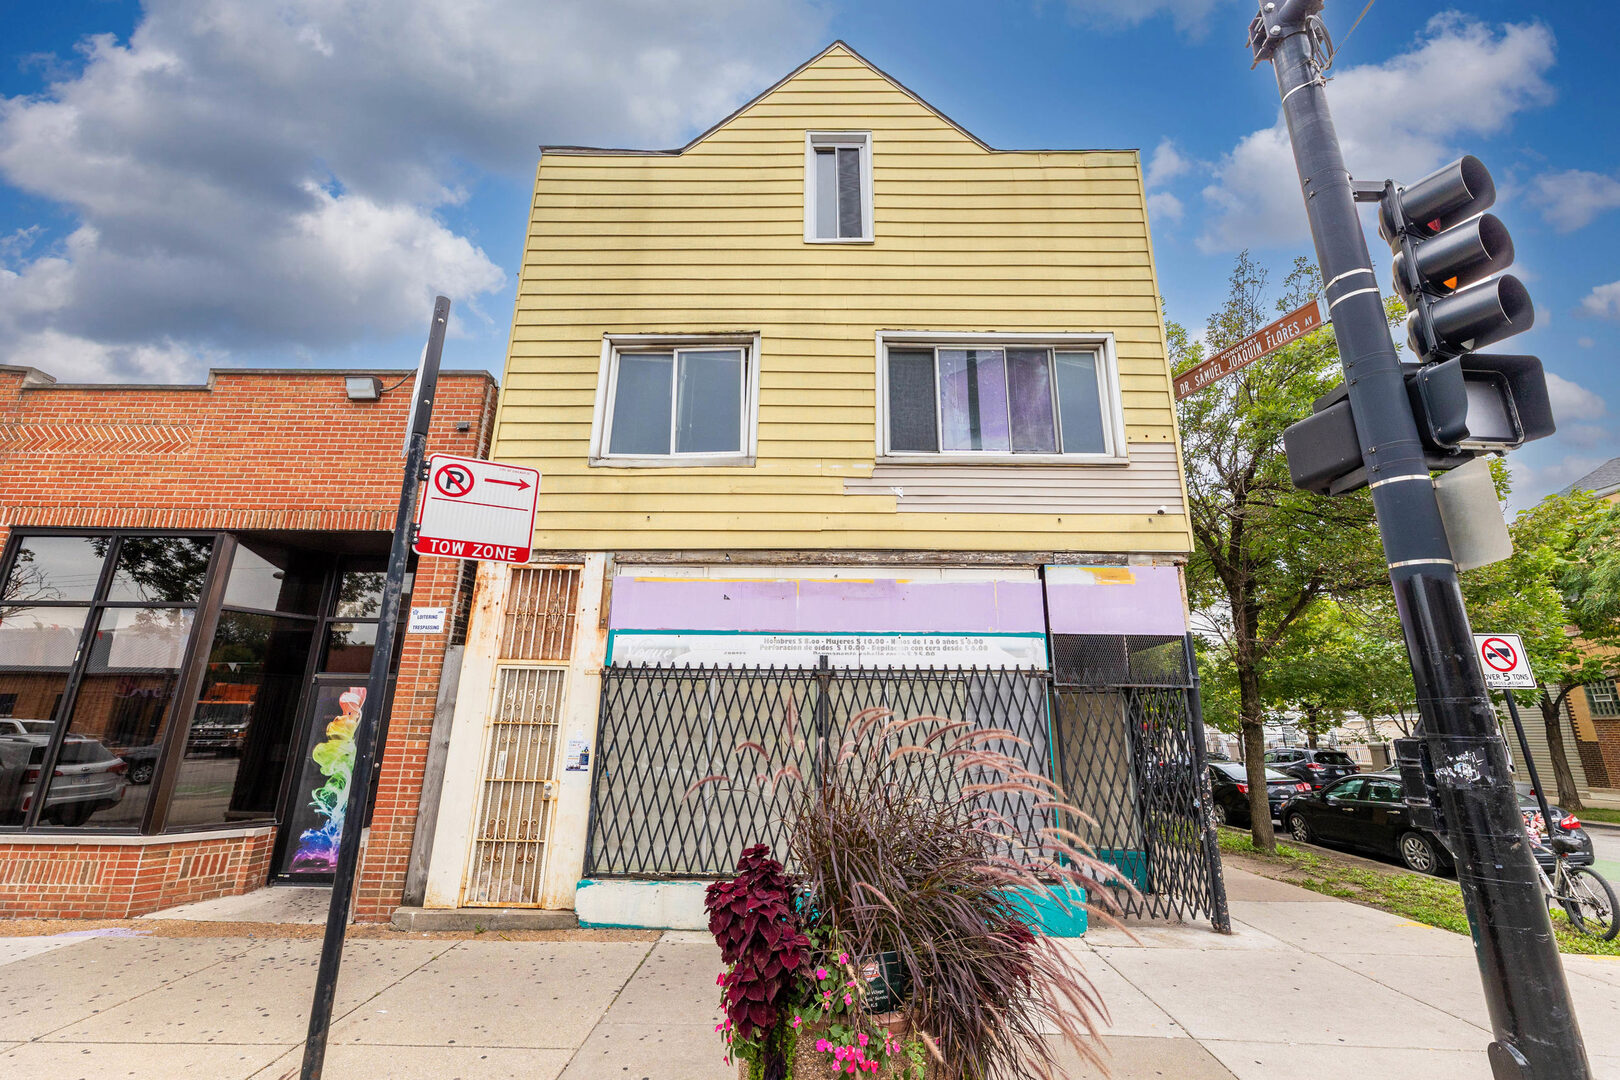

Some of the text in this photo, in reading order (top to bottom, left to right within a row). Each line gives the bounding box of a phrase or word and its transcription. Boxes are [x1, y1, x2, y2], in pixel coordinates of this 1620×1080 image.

[1180, 315, 1313, 395] DR. SAMUEL JOAQUIN FLORES AV
[1220, 336, 1257, 360] HONORARY
[430, 539, 518, 560] TOW ZONE
[1502, 672, 1510, 681] 5
